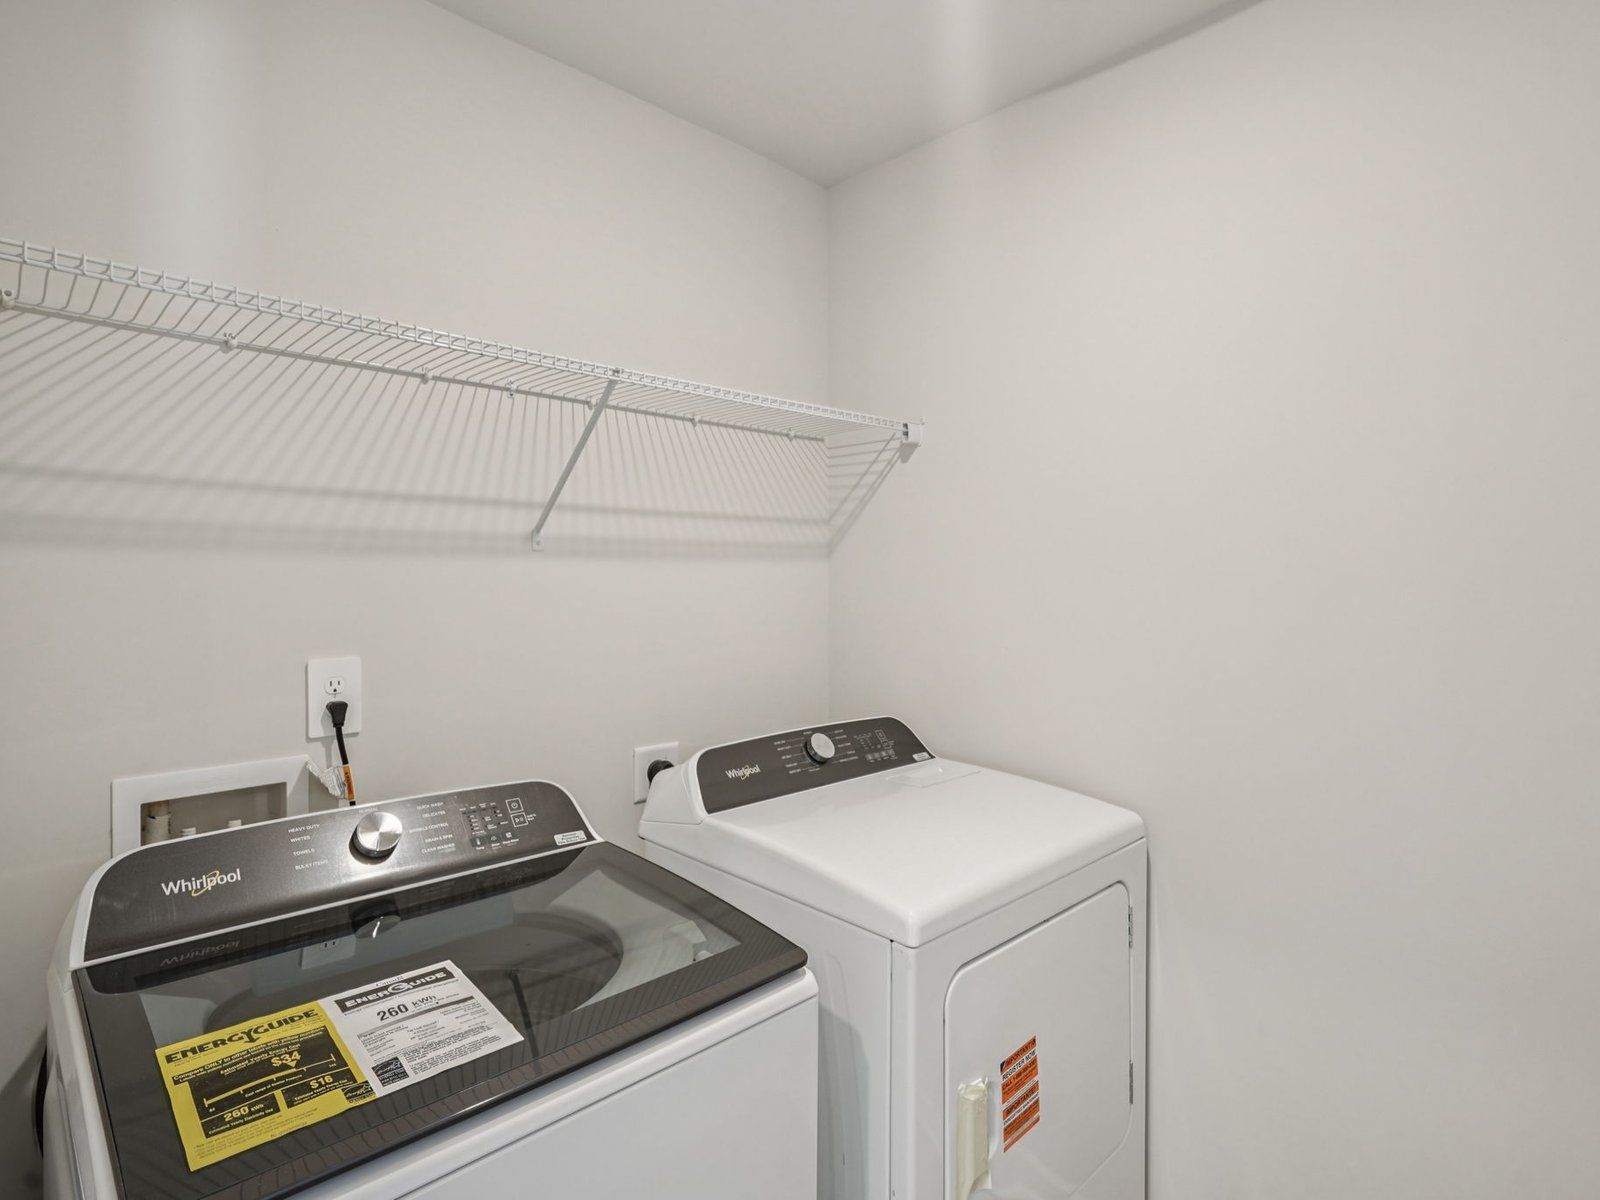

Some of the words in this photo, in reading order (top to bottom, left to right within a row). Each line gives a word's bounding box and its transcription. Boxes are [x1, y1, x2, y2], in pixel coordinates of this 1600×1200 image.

[725, 764, 761, 780] Whirlpool
[422, 810, 446, 818] DELICATES
[290, 835, 311, 843] WHITES
[293, 848, 316, 856] TOWELS
[161, 868, 241, 897] Whirlpool
[377, 1003, 409, 1021] 260
[412, 995, 437, 1007] kWh
[165, 1009, 318, 1064] ENERGYGUIDE
[204, 1060, 223, 1070] ONLY
[271, 1050, 301, 1068] $34
[309, 1075, 333, 1089] $16
[223, 1106, 249, 1122] 260
